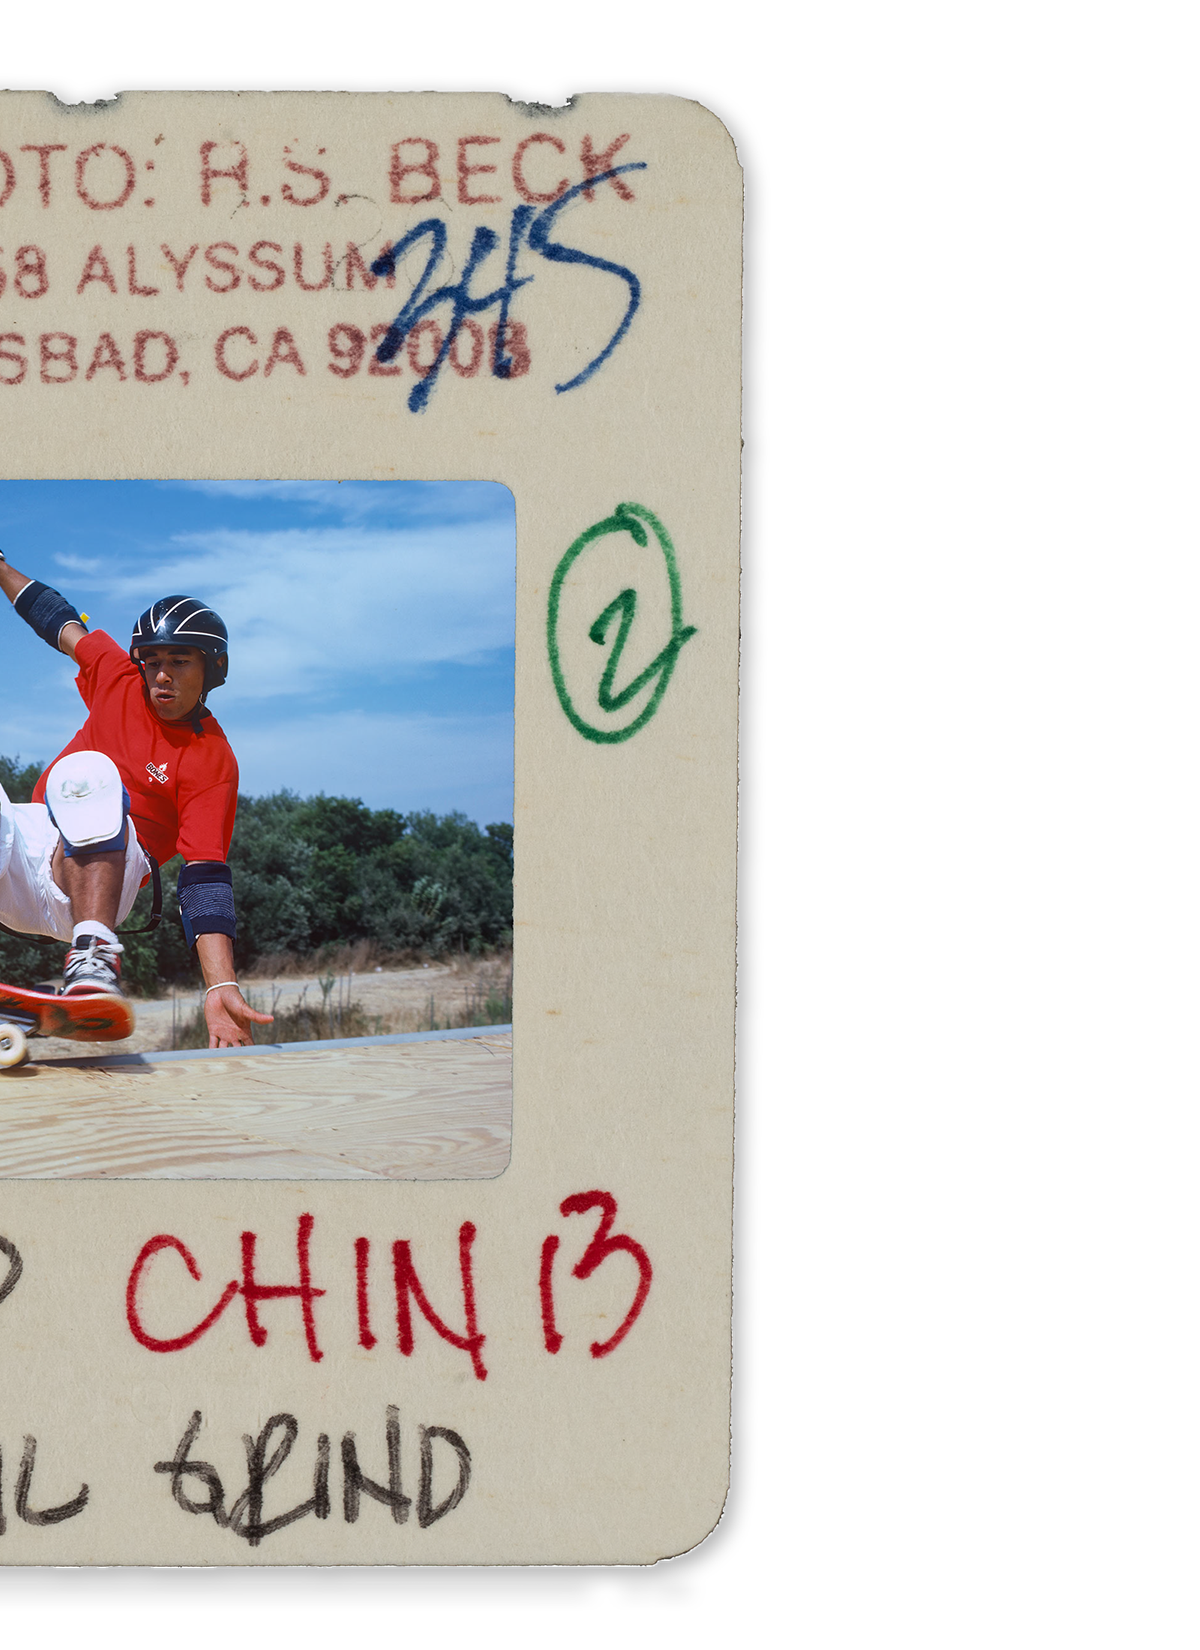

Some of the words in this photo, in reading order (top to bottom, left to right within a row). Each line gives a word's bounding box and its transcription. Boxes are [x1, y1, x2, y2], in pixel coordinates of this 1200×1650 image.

[389, 133, 636, 206] BECK
[77, 240, 398, 296] ALYSSUM
[215, 325, 307, 381] CA
[146, 763, 168, 783] BONES
[124, 1212, 490, 1382] CHIN
[538, 1188, 654, 1361] 13
[152, 1403, 474, 1547] GRIND
